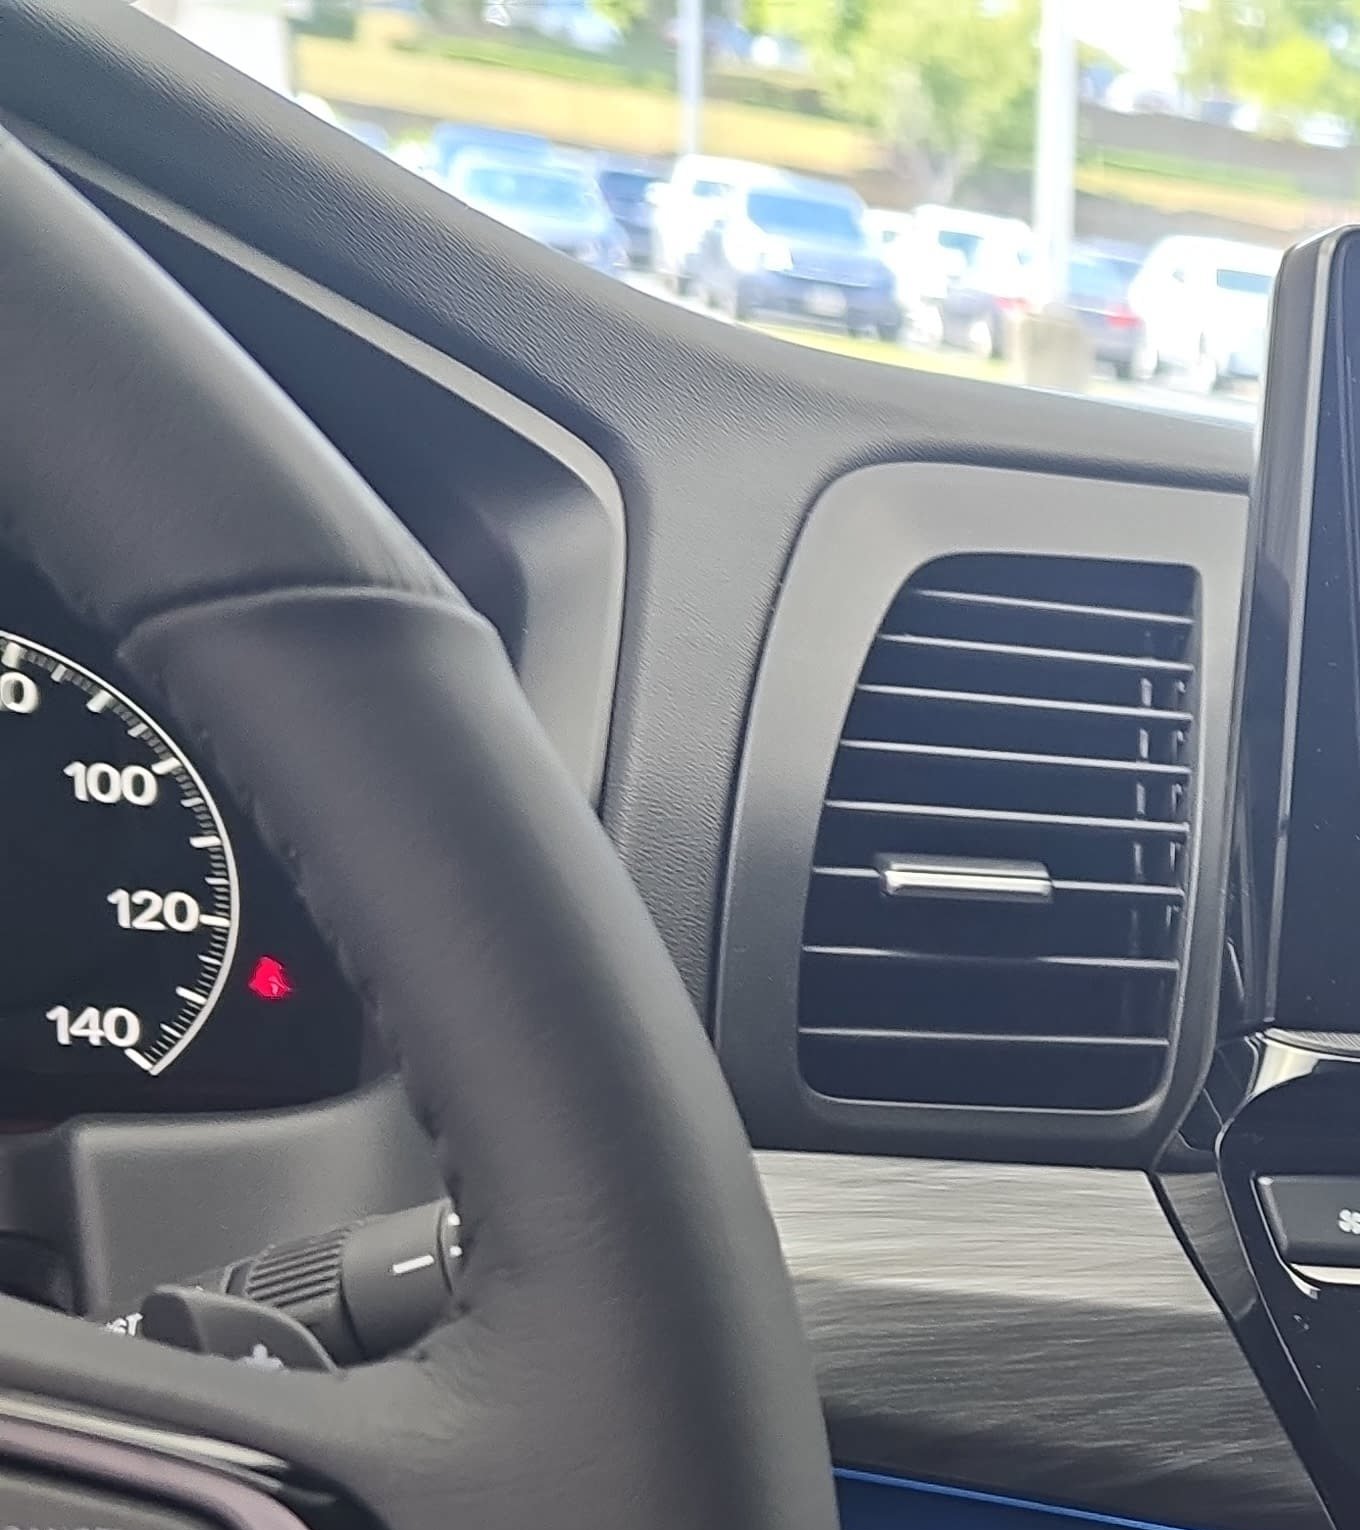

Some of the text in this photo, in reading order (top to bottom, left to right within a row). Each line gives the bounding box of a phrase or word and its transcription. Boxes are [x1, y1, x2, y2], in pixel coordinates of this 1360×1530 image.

[64, 761, 158, 806] 100
[107, 888, 200, 932] 120
[46, 1006, 140, 1048] 140
